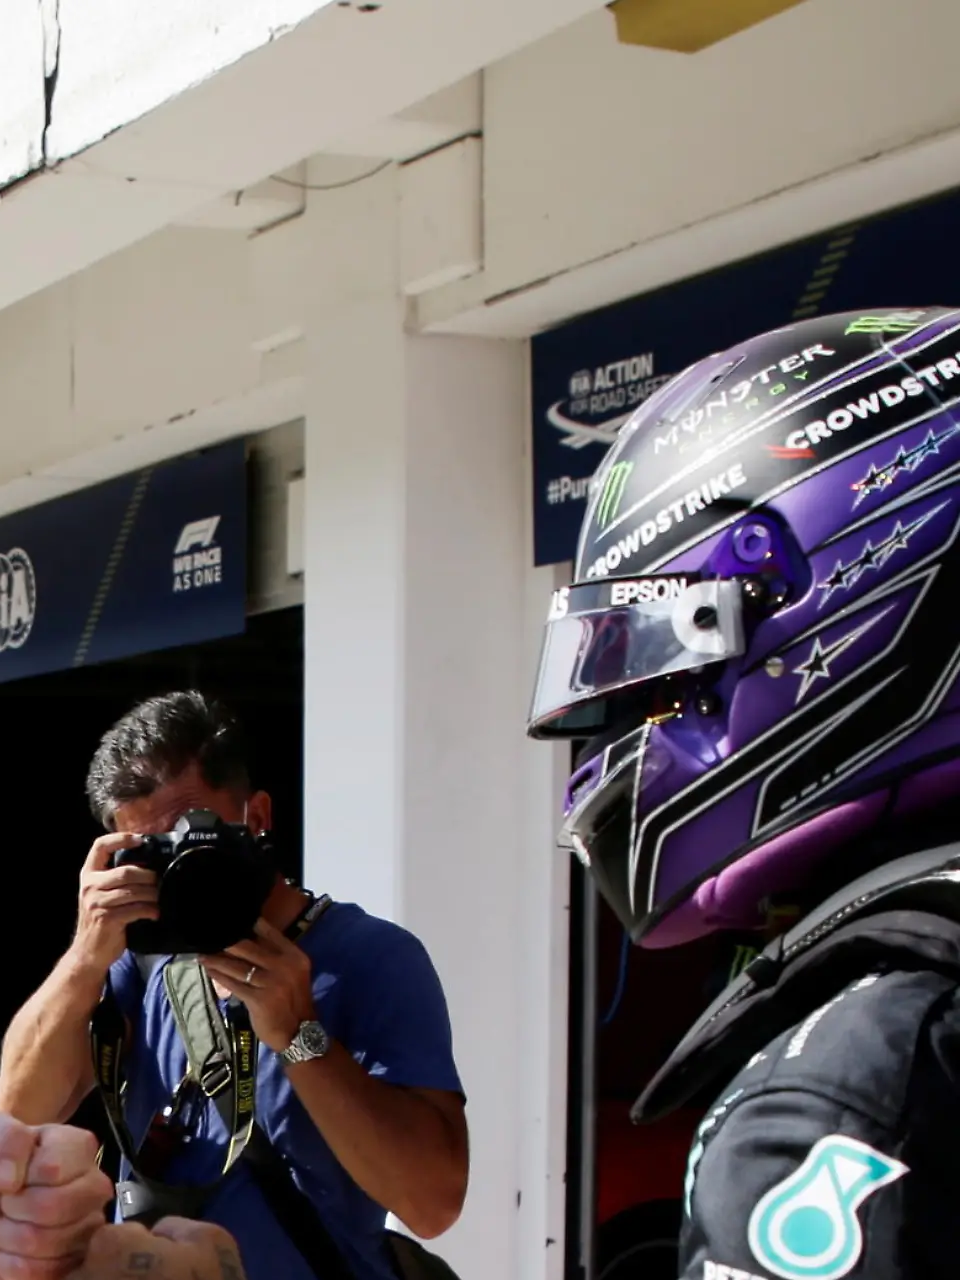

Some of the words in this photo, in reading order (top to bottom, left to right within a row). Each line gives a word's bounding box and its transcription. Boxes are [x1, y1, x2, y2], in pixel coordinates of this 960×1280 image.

[593, 352, 654, 391] ACTION
[785, 350, 960, 450] CROWDSTR
[548, 475, 593, 505] #Pur
[173, 573, 191, 592] AS
[194, 566, 221, 587] ONE
[610, 577, 688, 606] EPSON
[188, 831, 218, 841] Nikon
